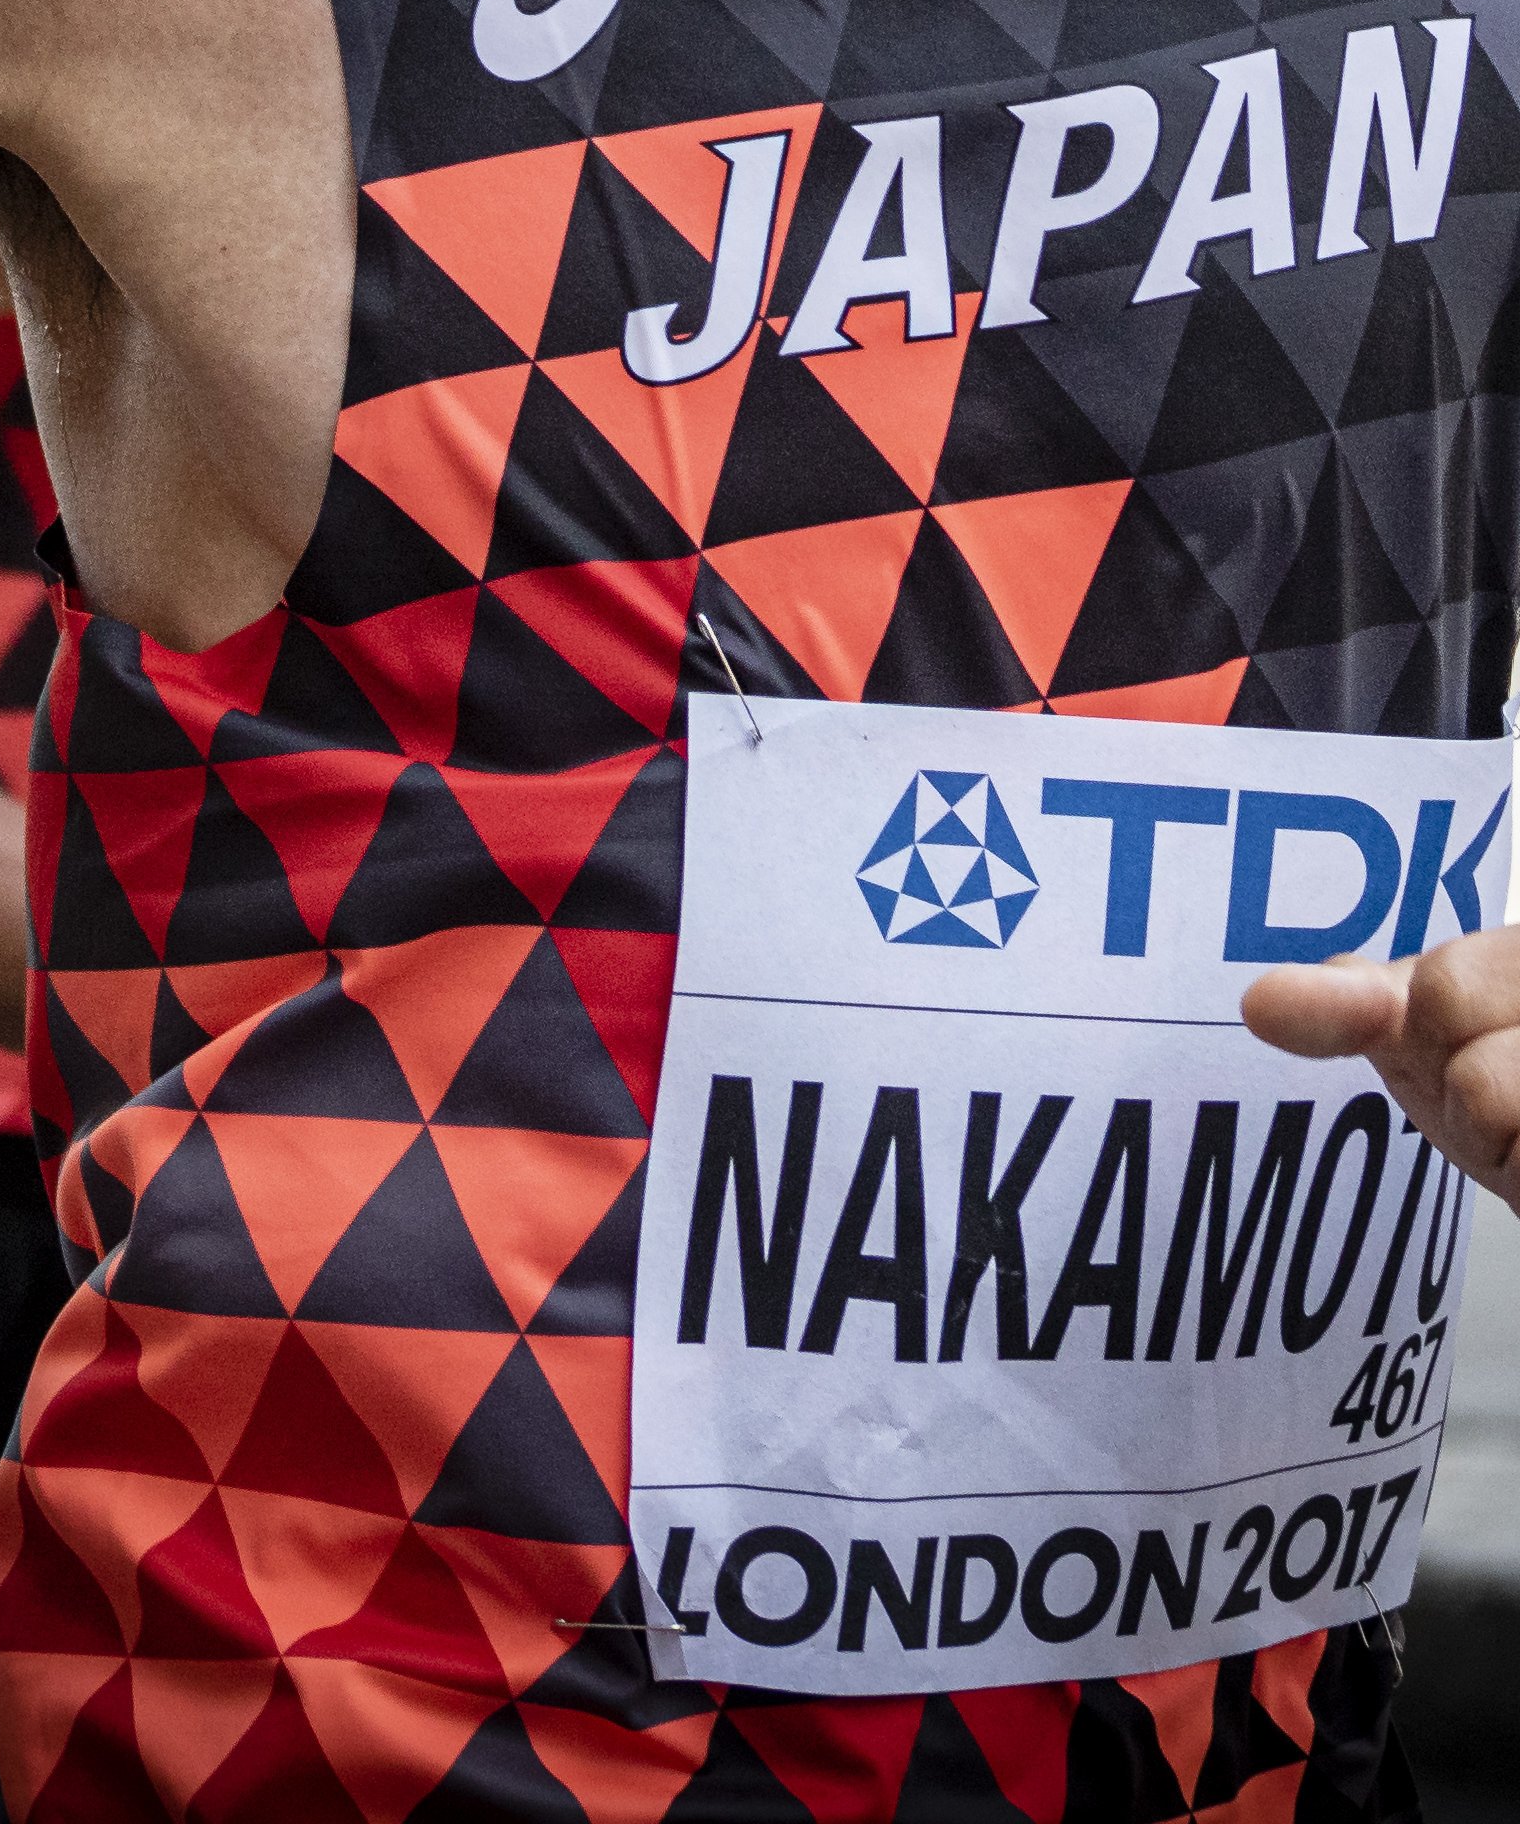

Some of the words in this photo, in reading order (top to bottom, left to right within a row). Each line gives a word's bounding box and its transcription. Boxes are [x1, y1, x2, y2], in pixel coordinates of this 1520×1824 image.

[620, 16, 1474, 385] JAPAN
[1041, 777, 1511, 964] TDK
[1329, 1315, 1448, 1443] 467
[655, 1520, 1212, 1653] LONDON
[1213, 1466, 1422, 1623] 2017
